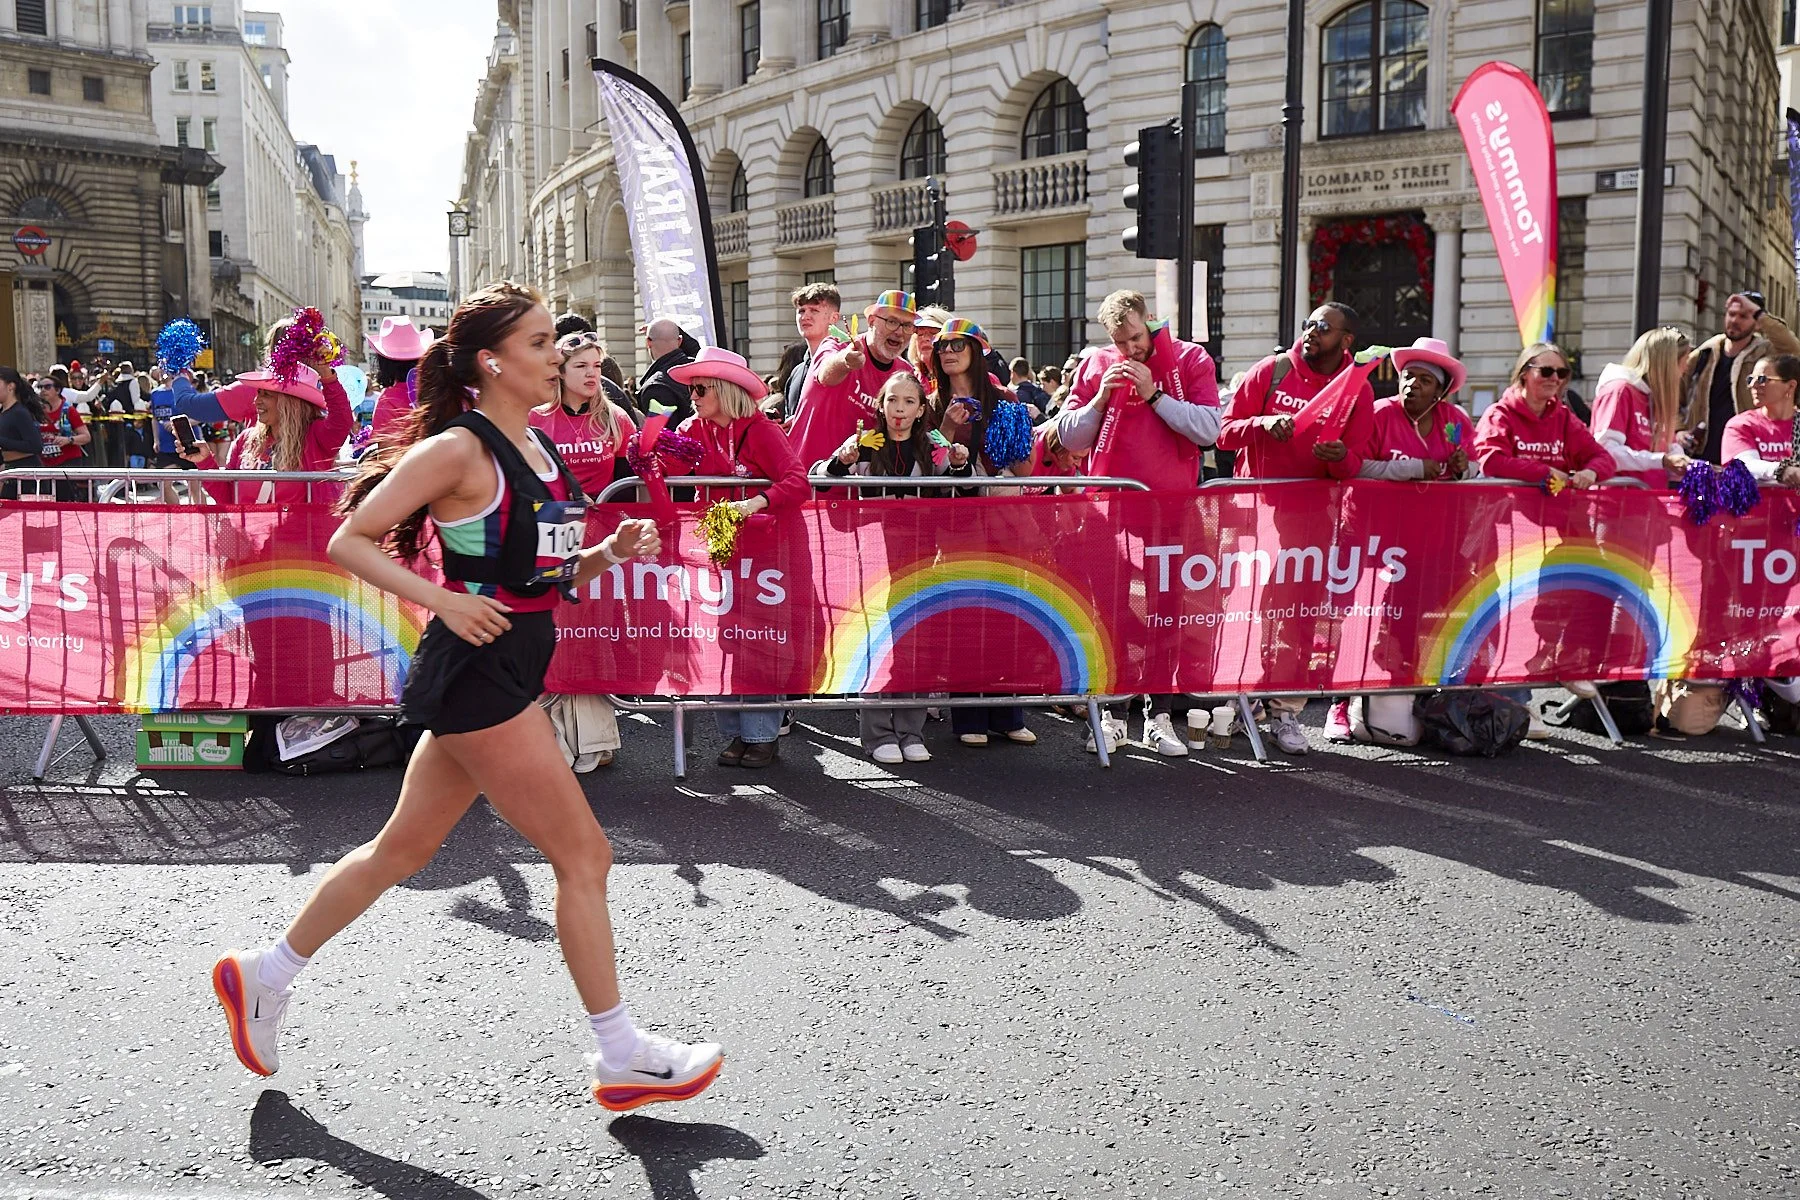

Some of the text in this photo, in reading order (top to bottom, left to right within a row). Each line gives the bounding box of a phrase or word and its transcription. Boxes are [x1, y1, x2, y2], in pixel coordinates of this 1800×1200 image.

[1308, 163, 1451, 187] LOMBARD STREET
[1308, 179, 1450, 197] RESTAURANT BAR BRASSERIE
[1171, 366, 1185, 401] Tomm
[1095, 407, 1115, 453] Tommy's
[1145, 535, 1407, 594] Tommy's
[569, 558, 787, 616] mmy's
[1145, 601, 1403, 629] The pregnancy and baby charity
[1728, 603, 1755, 617] The
[16, 632, 84, 652] charity
[626, 622, 662, 639] and
[669, 623, 717, 642] baby
[723, 623, 787, 643] charity
